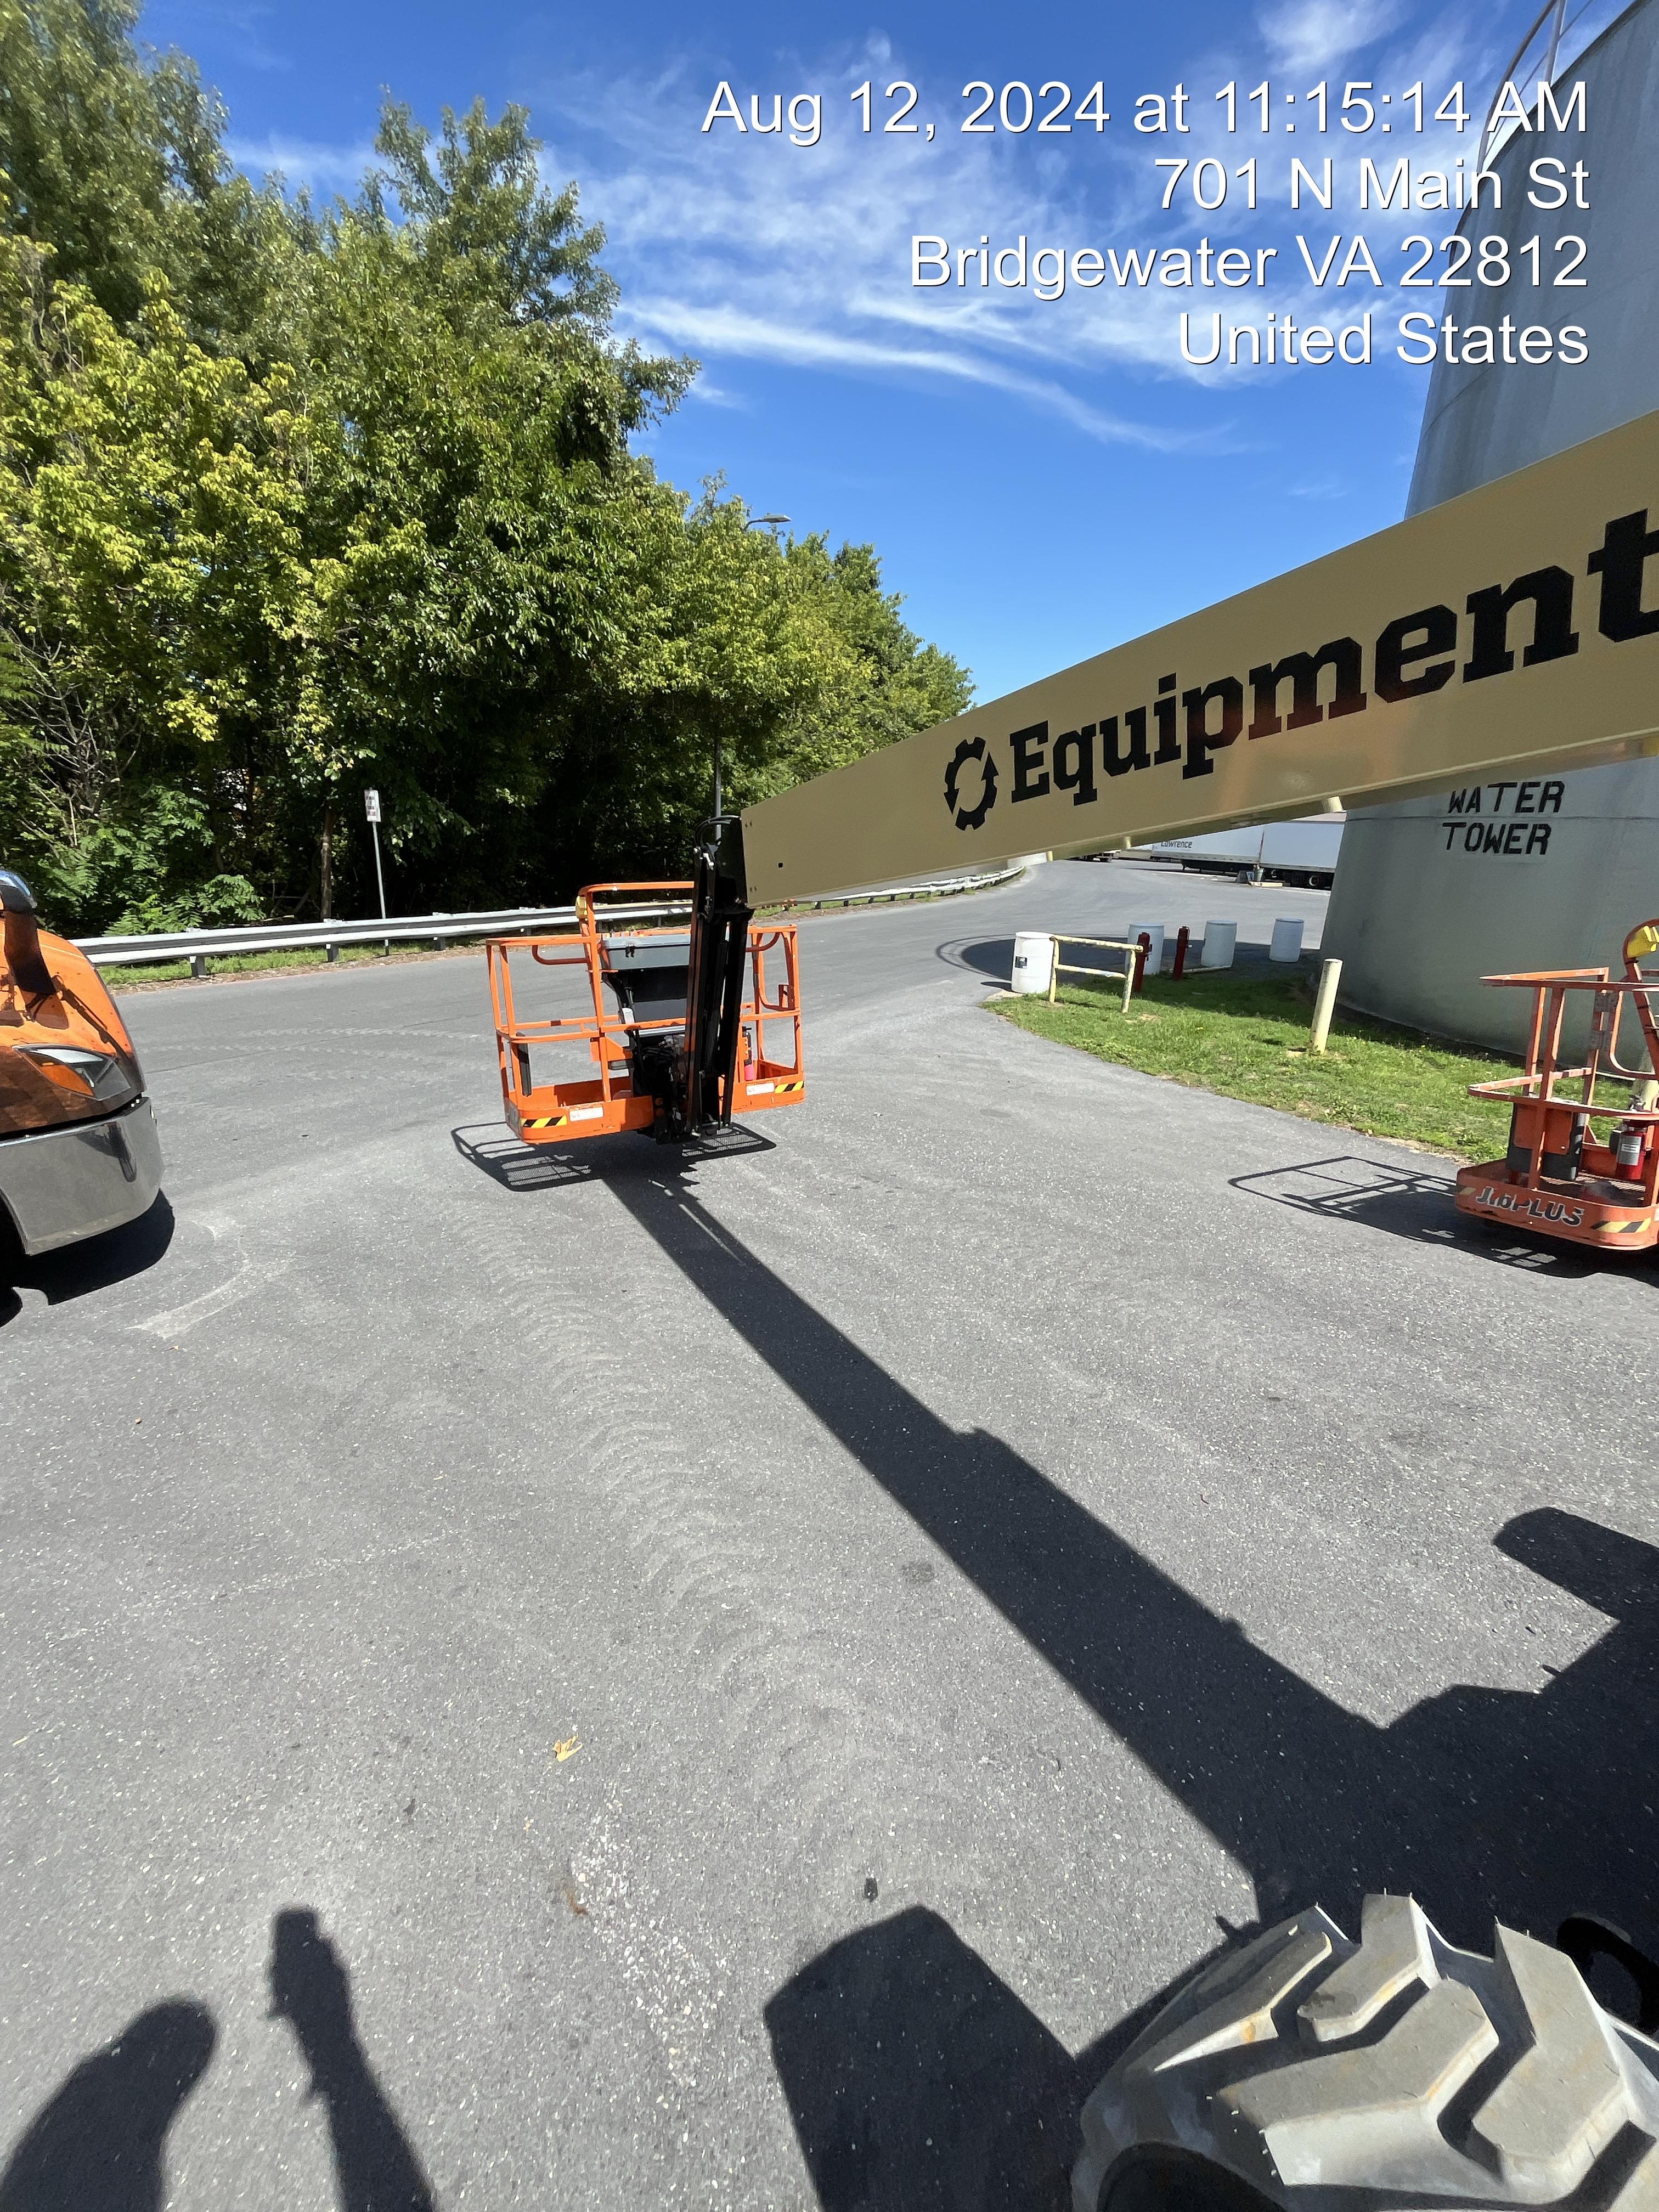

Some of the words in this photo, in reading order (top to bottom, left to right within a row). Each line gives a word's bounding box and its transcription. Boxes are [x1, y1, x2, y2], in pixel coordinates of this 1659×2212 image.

[1011, 509, 1659, 805] Equipment
[1448, 781, 1565, 813] WATER
[1442, 822, 1551, 855] TOWER
